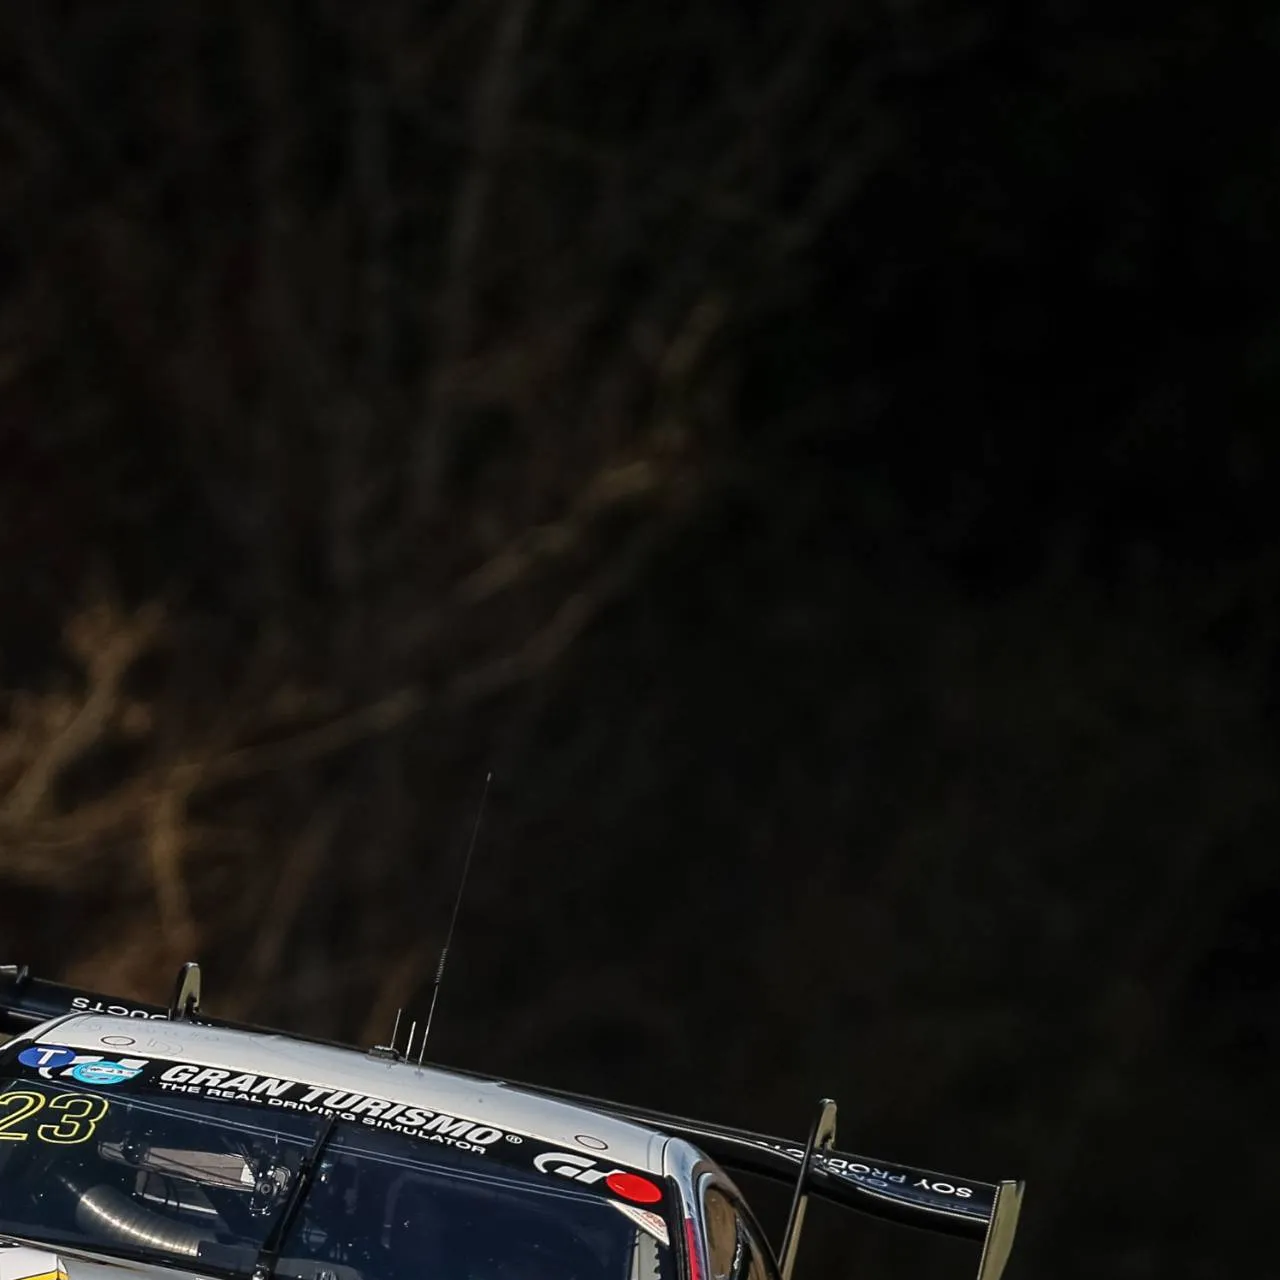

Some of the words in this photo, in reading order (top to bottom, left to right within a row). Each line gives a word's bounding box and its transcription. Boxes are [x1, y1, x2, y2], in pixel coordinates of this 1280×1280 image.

[159, 1082, 200, 1094] THE
[207, 1088, 262, 1104] REAL
[362, 1117, 486, 1155] SIMULATOR
[160, 1065, 296, 1097] GRAN
[299, 1085, 504, 1146] TURISMO
[913, 1177, 974, 1199] SOY
